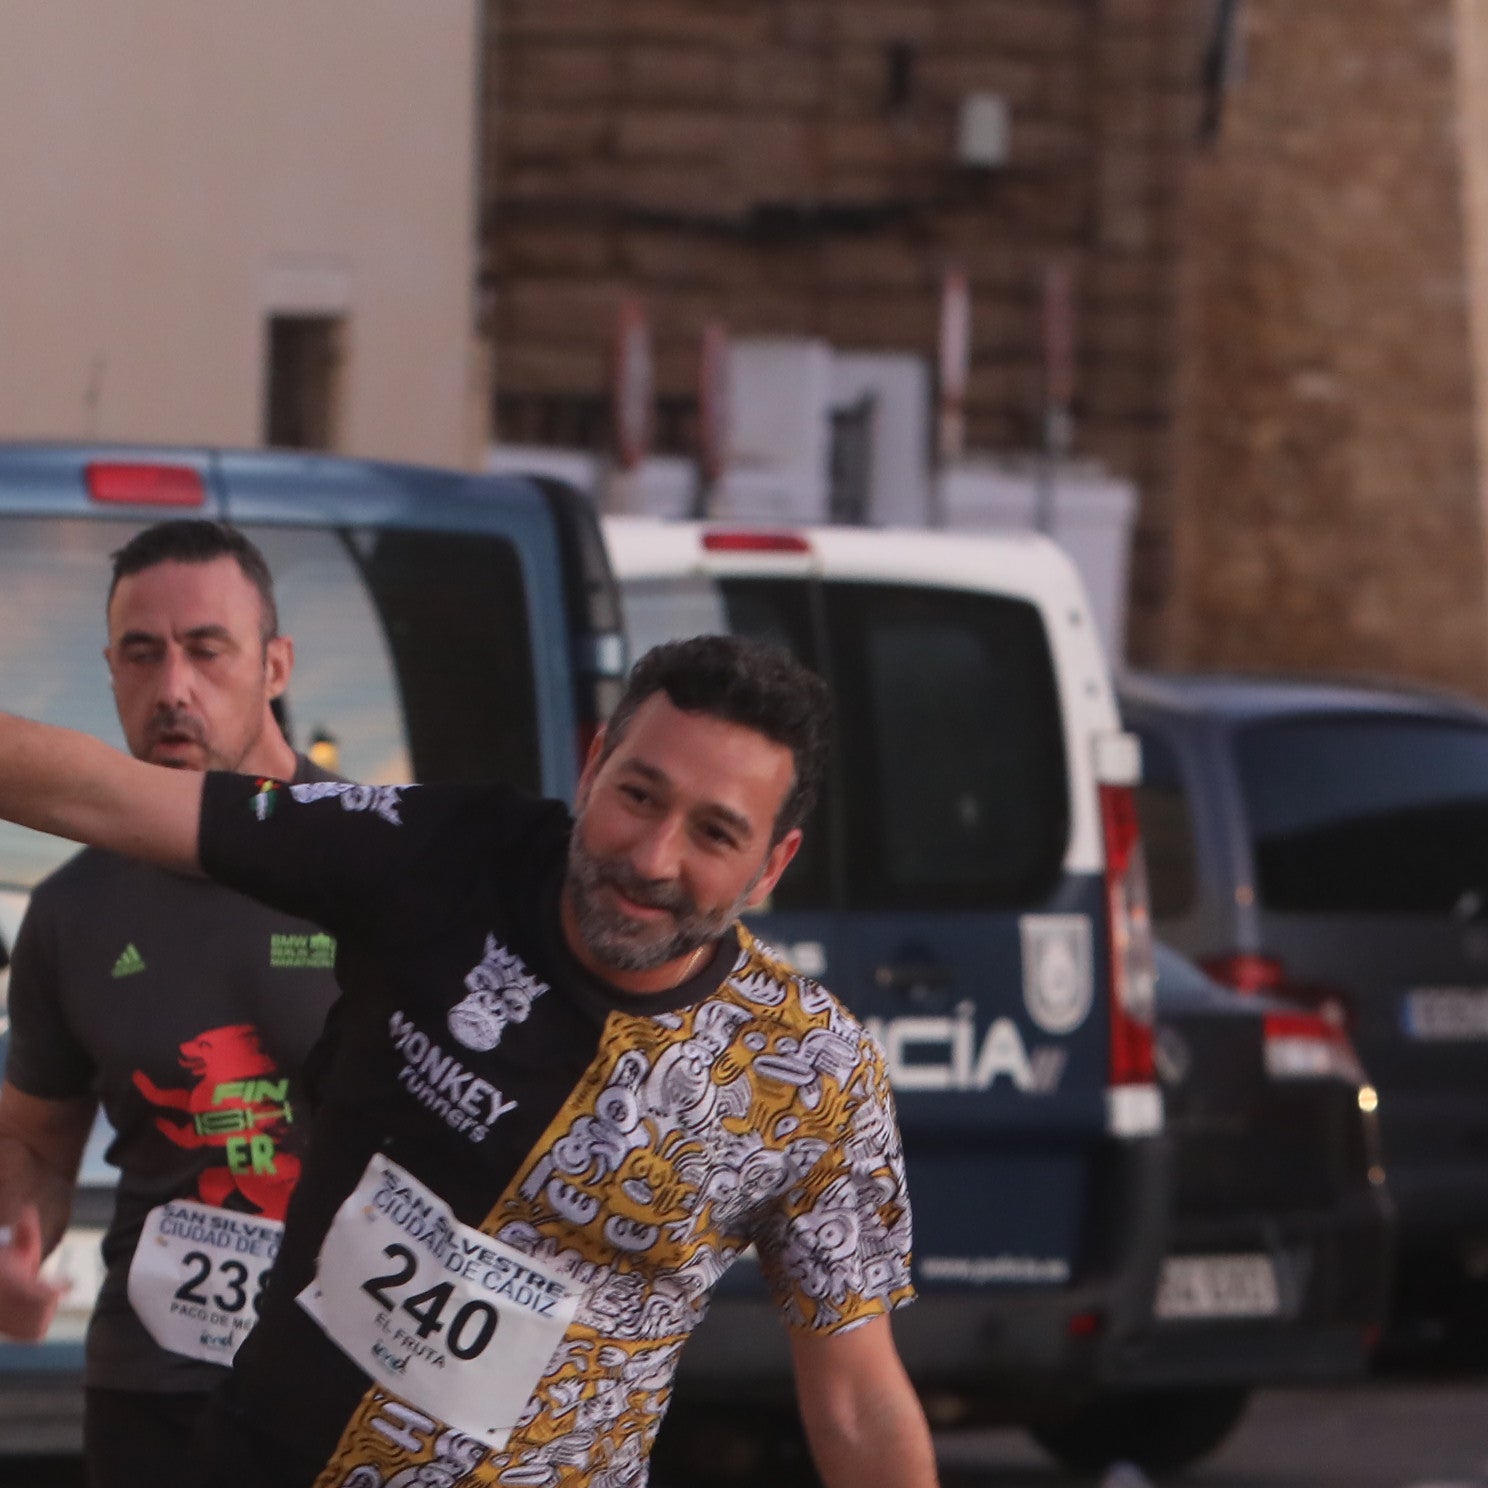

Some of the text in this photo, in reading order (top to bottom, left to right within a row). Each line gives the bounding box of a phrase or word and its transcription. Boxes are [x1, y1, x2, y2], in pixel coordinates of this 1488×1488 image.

[211, 1077, 290, 1106] FIN
[388, 1010, 520, 1127] MONKEY
[397, 1064, 491, 1144] runners
[226, 1133, 277, 1175] ER
[160, 1217, 232, 1248] CIUDAD
[235, 1235, 263, 1257] DE
[164, 1203, 286, 1242] SAN SILVES
[373, 1187, 448, 1260] CIUDAD
[445, 1250, 481, 1282] DE
[379, 1168, 567, 1298] SAN SILVESTRE
[170, 1301, 207, 1321] PACO
[361, 1241, 500, 1361] 240
[374, 1311, 446, 1369] EL FRUTA
